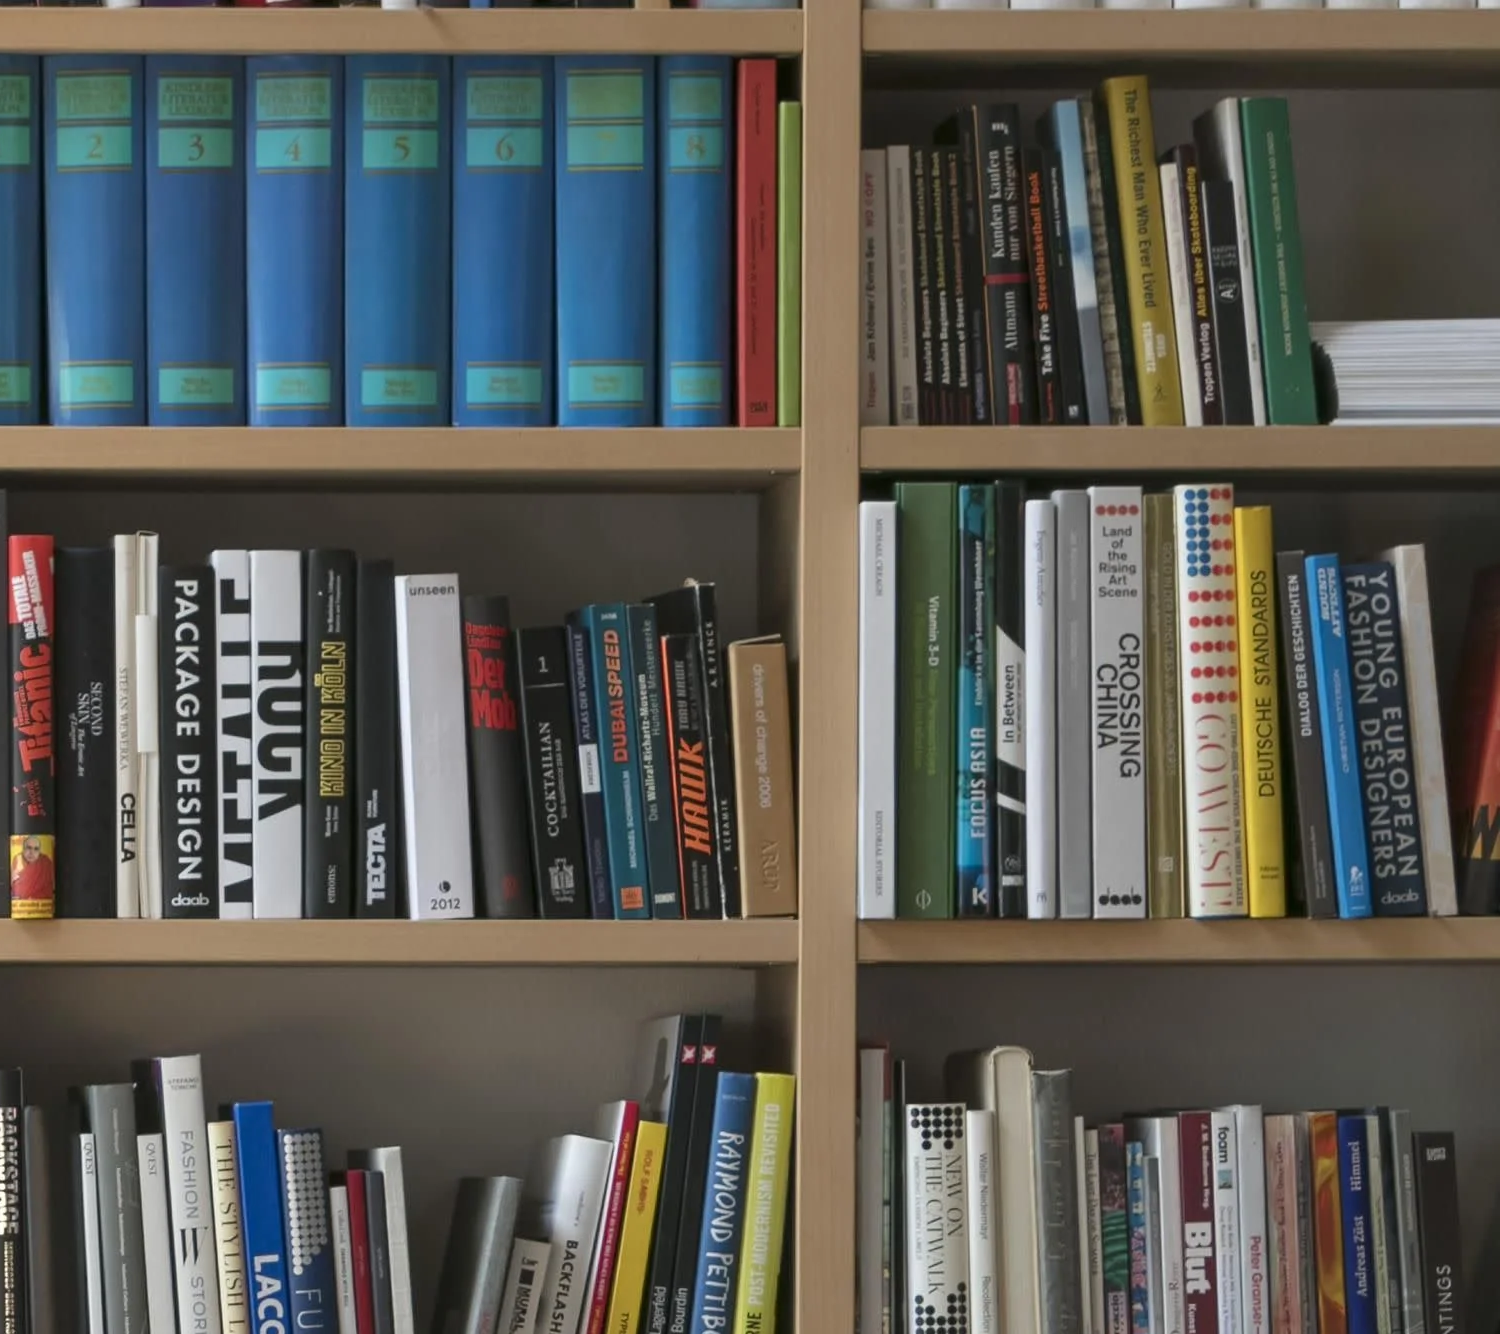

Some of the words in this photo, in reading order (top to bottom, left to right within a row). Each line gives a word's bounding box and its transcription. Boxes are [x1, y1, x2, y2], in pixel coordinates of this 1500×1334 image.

[1123, 89, 1138, 115] The
[188, 136, 204, 161] 3
[495, 132, 514, 161] 6
[1126, 118, 1143, 167] Richest
[1133, 171, 1145, 203] Man
[1135, 205, 1148, 238] Who
[1186, 167, 1202, 255] Skateboarding
[1139, 241, 1151, 271] Ever
[1142, 273, 1156, 308] Lived
[1196, 290, 1207, 317] Alles
[1102, 526, 1132, 537] Land
[1111, 538, 1124, 549] of
[1099, 562, 1136, 576] Rising
[1107, 550, 1128, 562] the
[409, 584, 455, 596] unseen
[1099, 586, 1137, 598] Scene
[1107, 574, 1127, 586] Art
[1253, 570, 1272, 684] STANDARDS
[1344, 574, 1378, 704] FASHION
[1368, 571, 1398, 689] YOUNG
[175, 579, 200, 737] PACKAGE
[314, 641, 346, 703] KÖLN
[468, 650, 505, 688] Der
[472, 692, 516, 730] Mob
[1003, 664, 1014, 726] Between
[1097, 663, 1118, 749] CHINA
[1118, 632, 1141, 779] CROSSING
[321, 710, 345, 734] IN
[1003, 729, 1013, 743] In
[320, 740, 345, 796] KINO
[971, 727, 986, 772] ASIA
[1258, 697, 1274, 798] DEUTSCHE
[538, 721, 559, 838] COCKTAILIAN
[1359, 718, 1395, 878] DESIGNERS
[1382, 707, 1418, 876] EUROPEAN
[119, 792, 136, 864] CELLA
[177, 755, 202, 880] DESIGN
[969, 777, 986, 838] FOCUS
[367, 823, 386, 905] TECTA
[171, 893, 210, 906] daab
[430, 898, 461, 910] 2012
[672, 1287, 688, 1332] Bourdin
